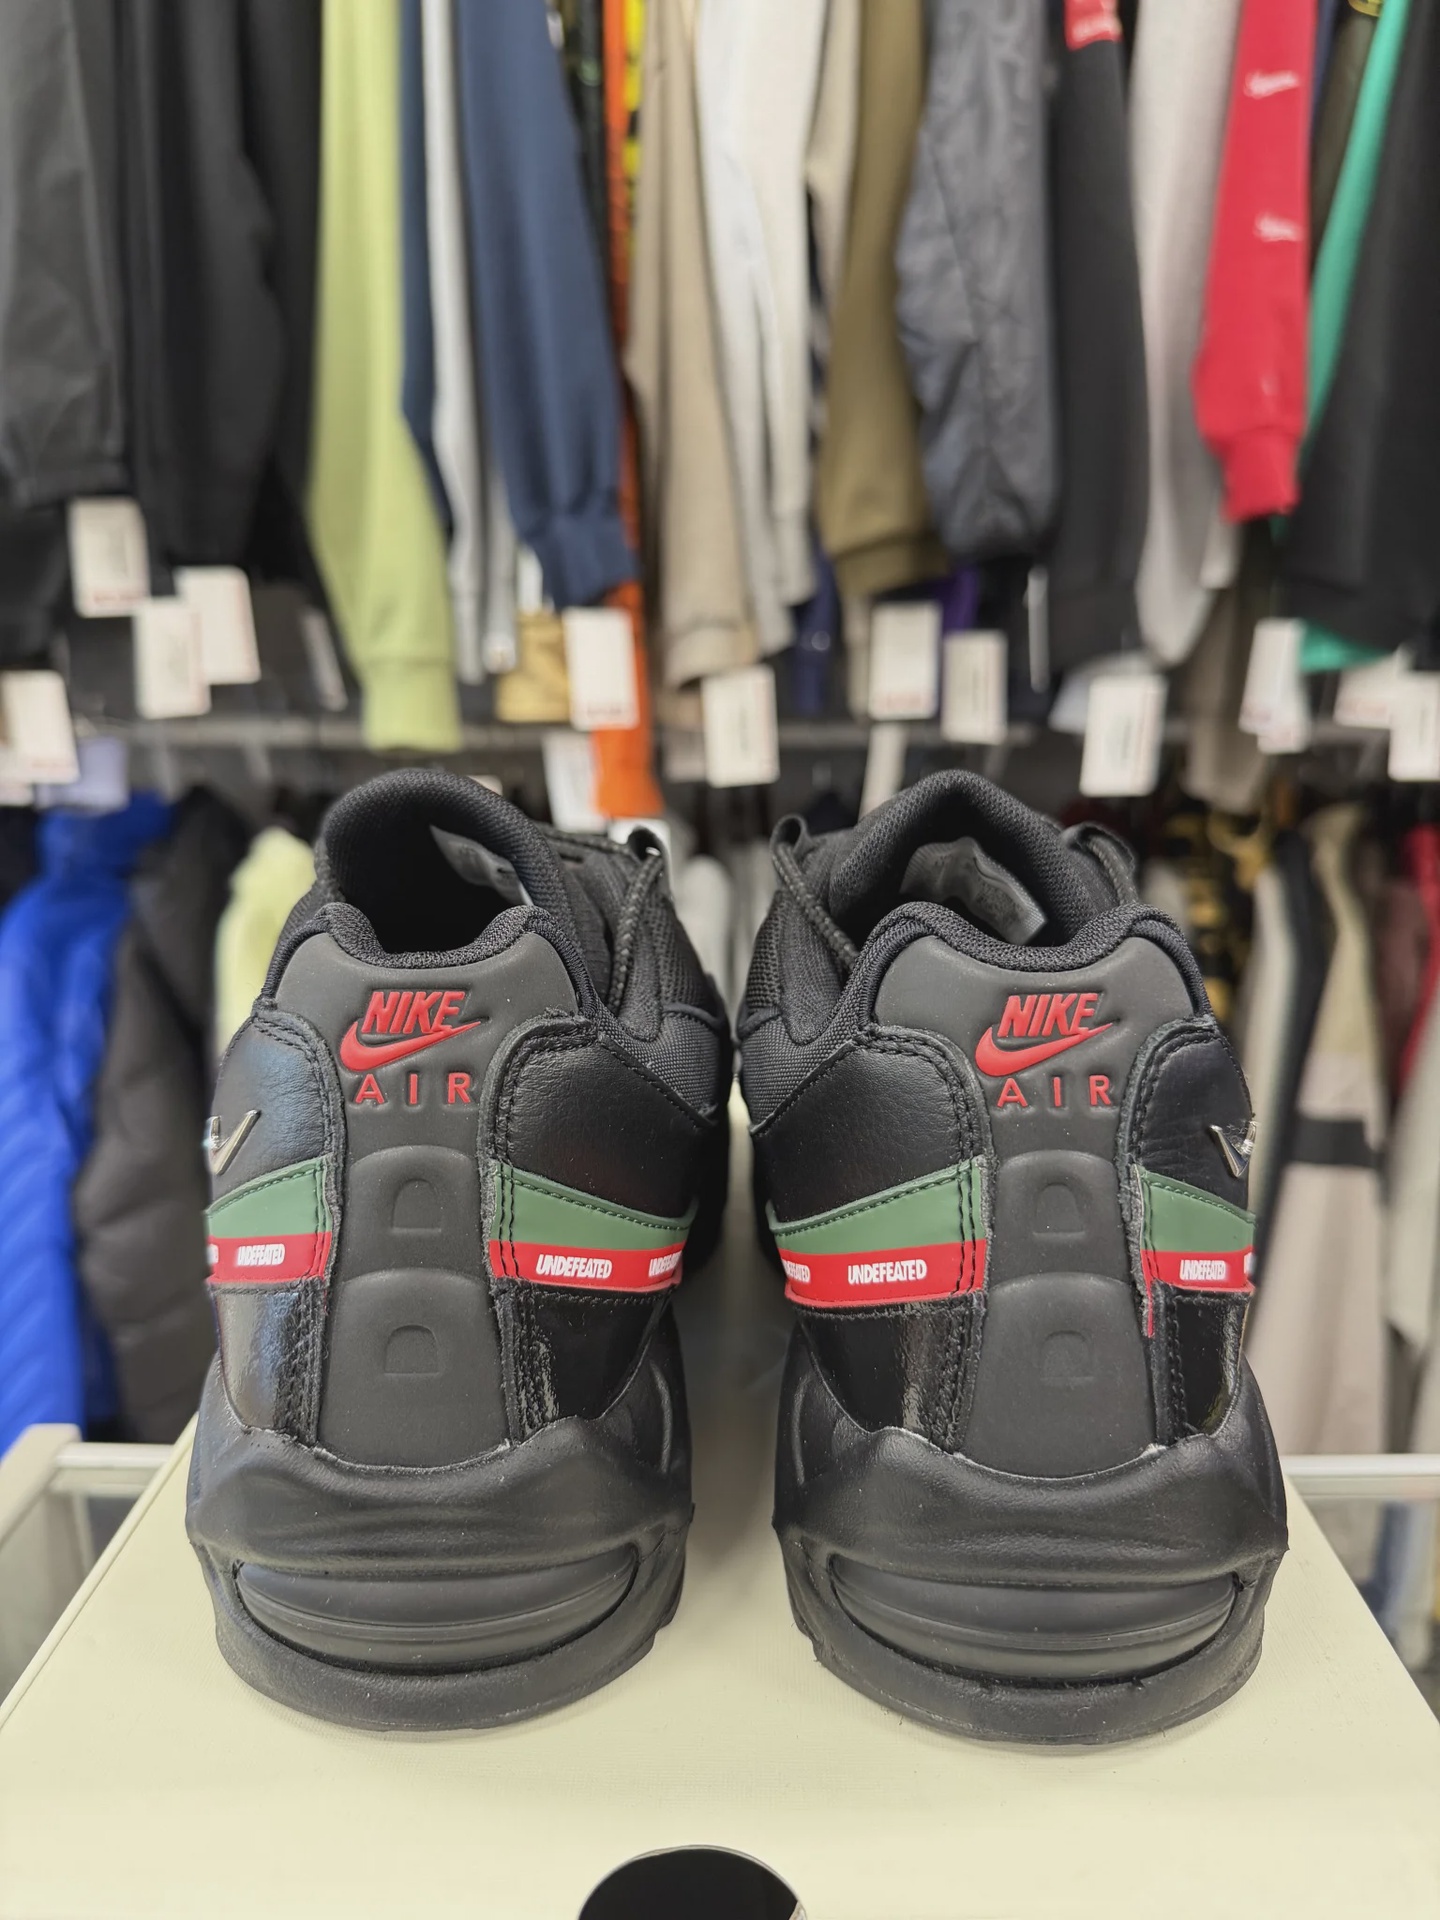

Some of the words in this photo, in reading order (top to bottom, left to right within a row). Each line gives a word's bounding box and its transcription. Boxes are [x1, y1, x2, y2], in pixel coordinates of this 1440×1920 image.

[361, 991, 466, 1034] NIKE
[997, 992, 1098, 1037] NIKE
[355, 1072, 471, 1105] AIR
[997, 1074, 1111, 1107] AIR
[236, 1243, 285, 1267] UNDEFEATED
[535, 1254, 613, 1279] UNDEFEATED
[1179, 1259, 1226, 1280] UNDEFEATED
[847, 1259, 928, 1285] UNDEFEATED
